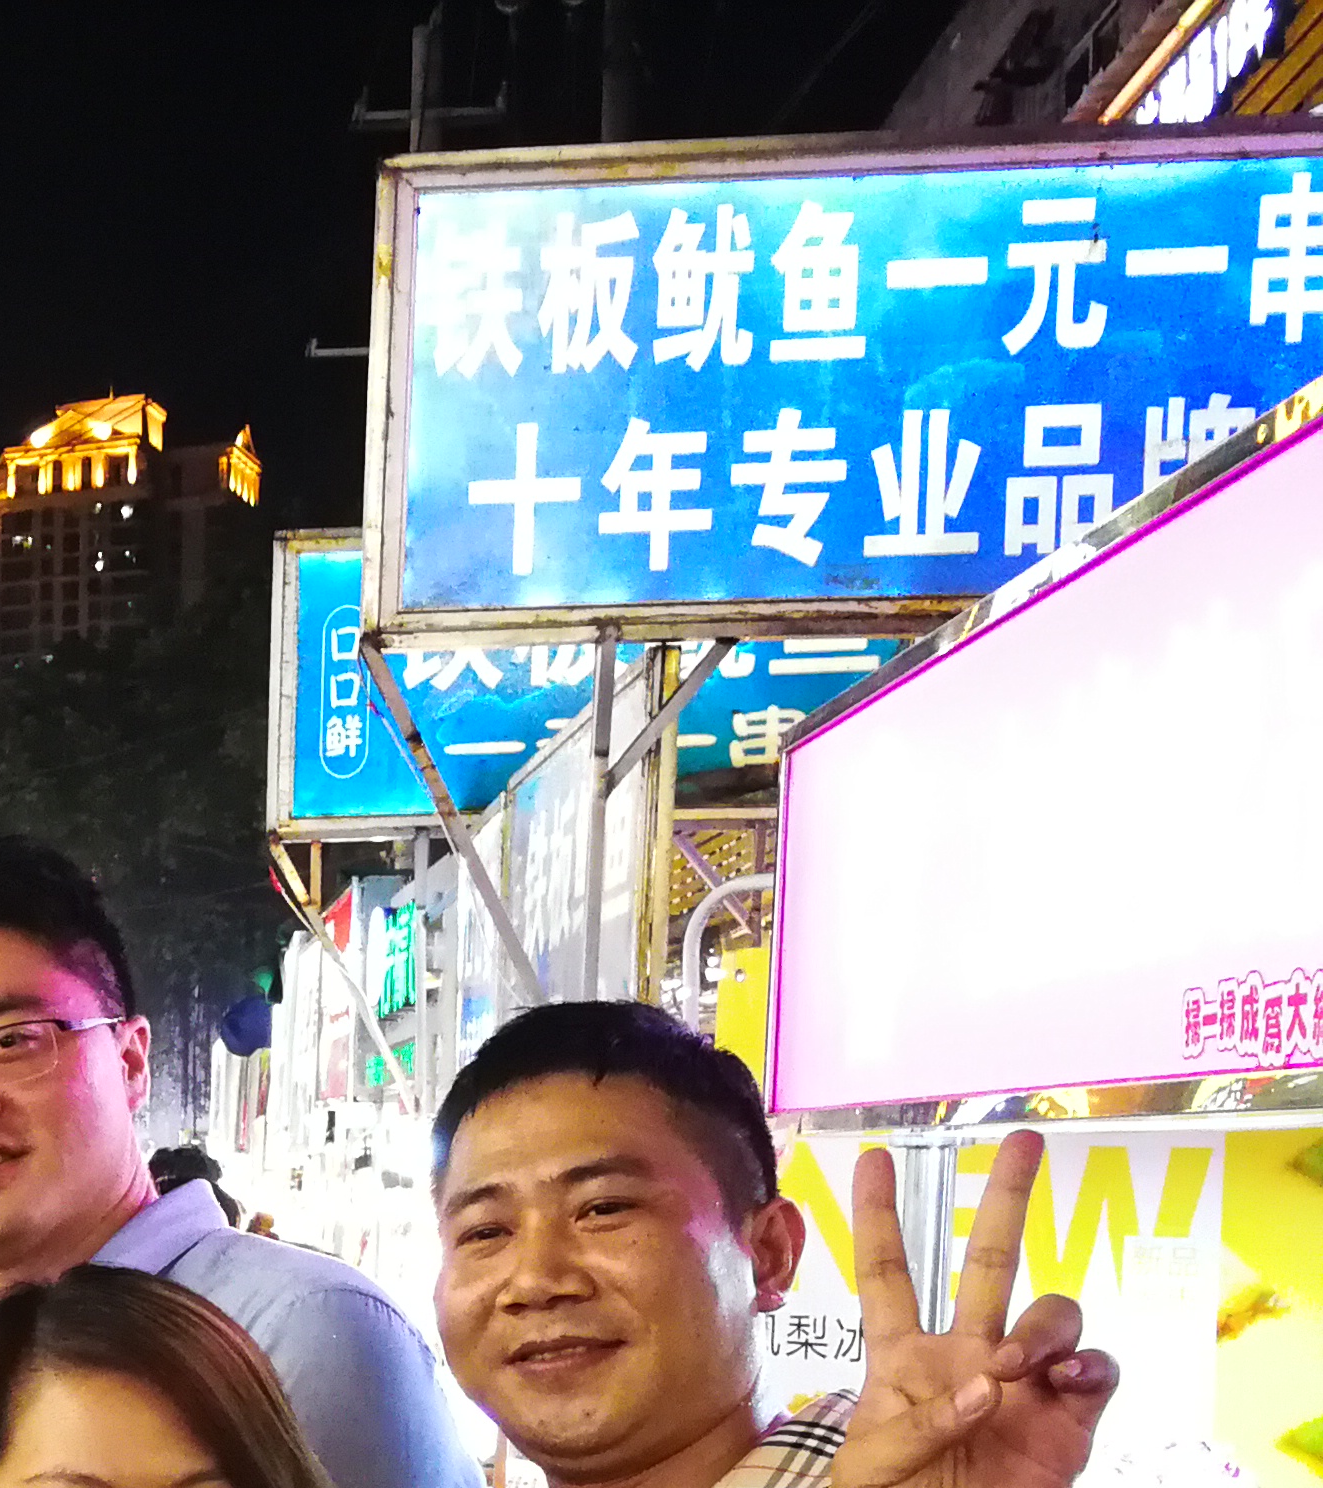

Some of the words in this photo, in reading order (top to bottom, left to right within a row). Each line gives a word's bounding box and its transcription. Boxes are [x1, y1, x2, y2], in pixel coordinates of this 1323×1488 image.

[421, 171, 1323, 379] 铁板鱿鱼一元一串
[324, 625, 363, 758] 口口鲜
